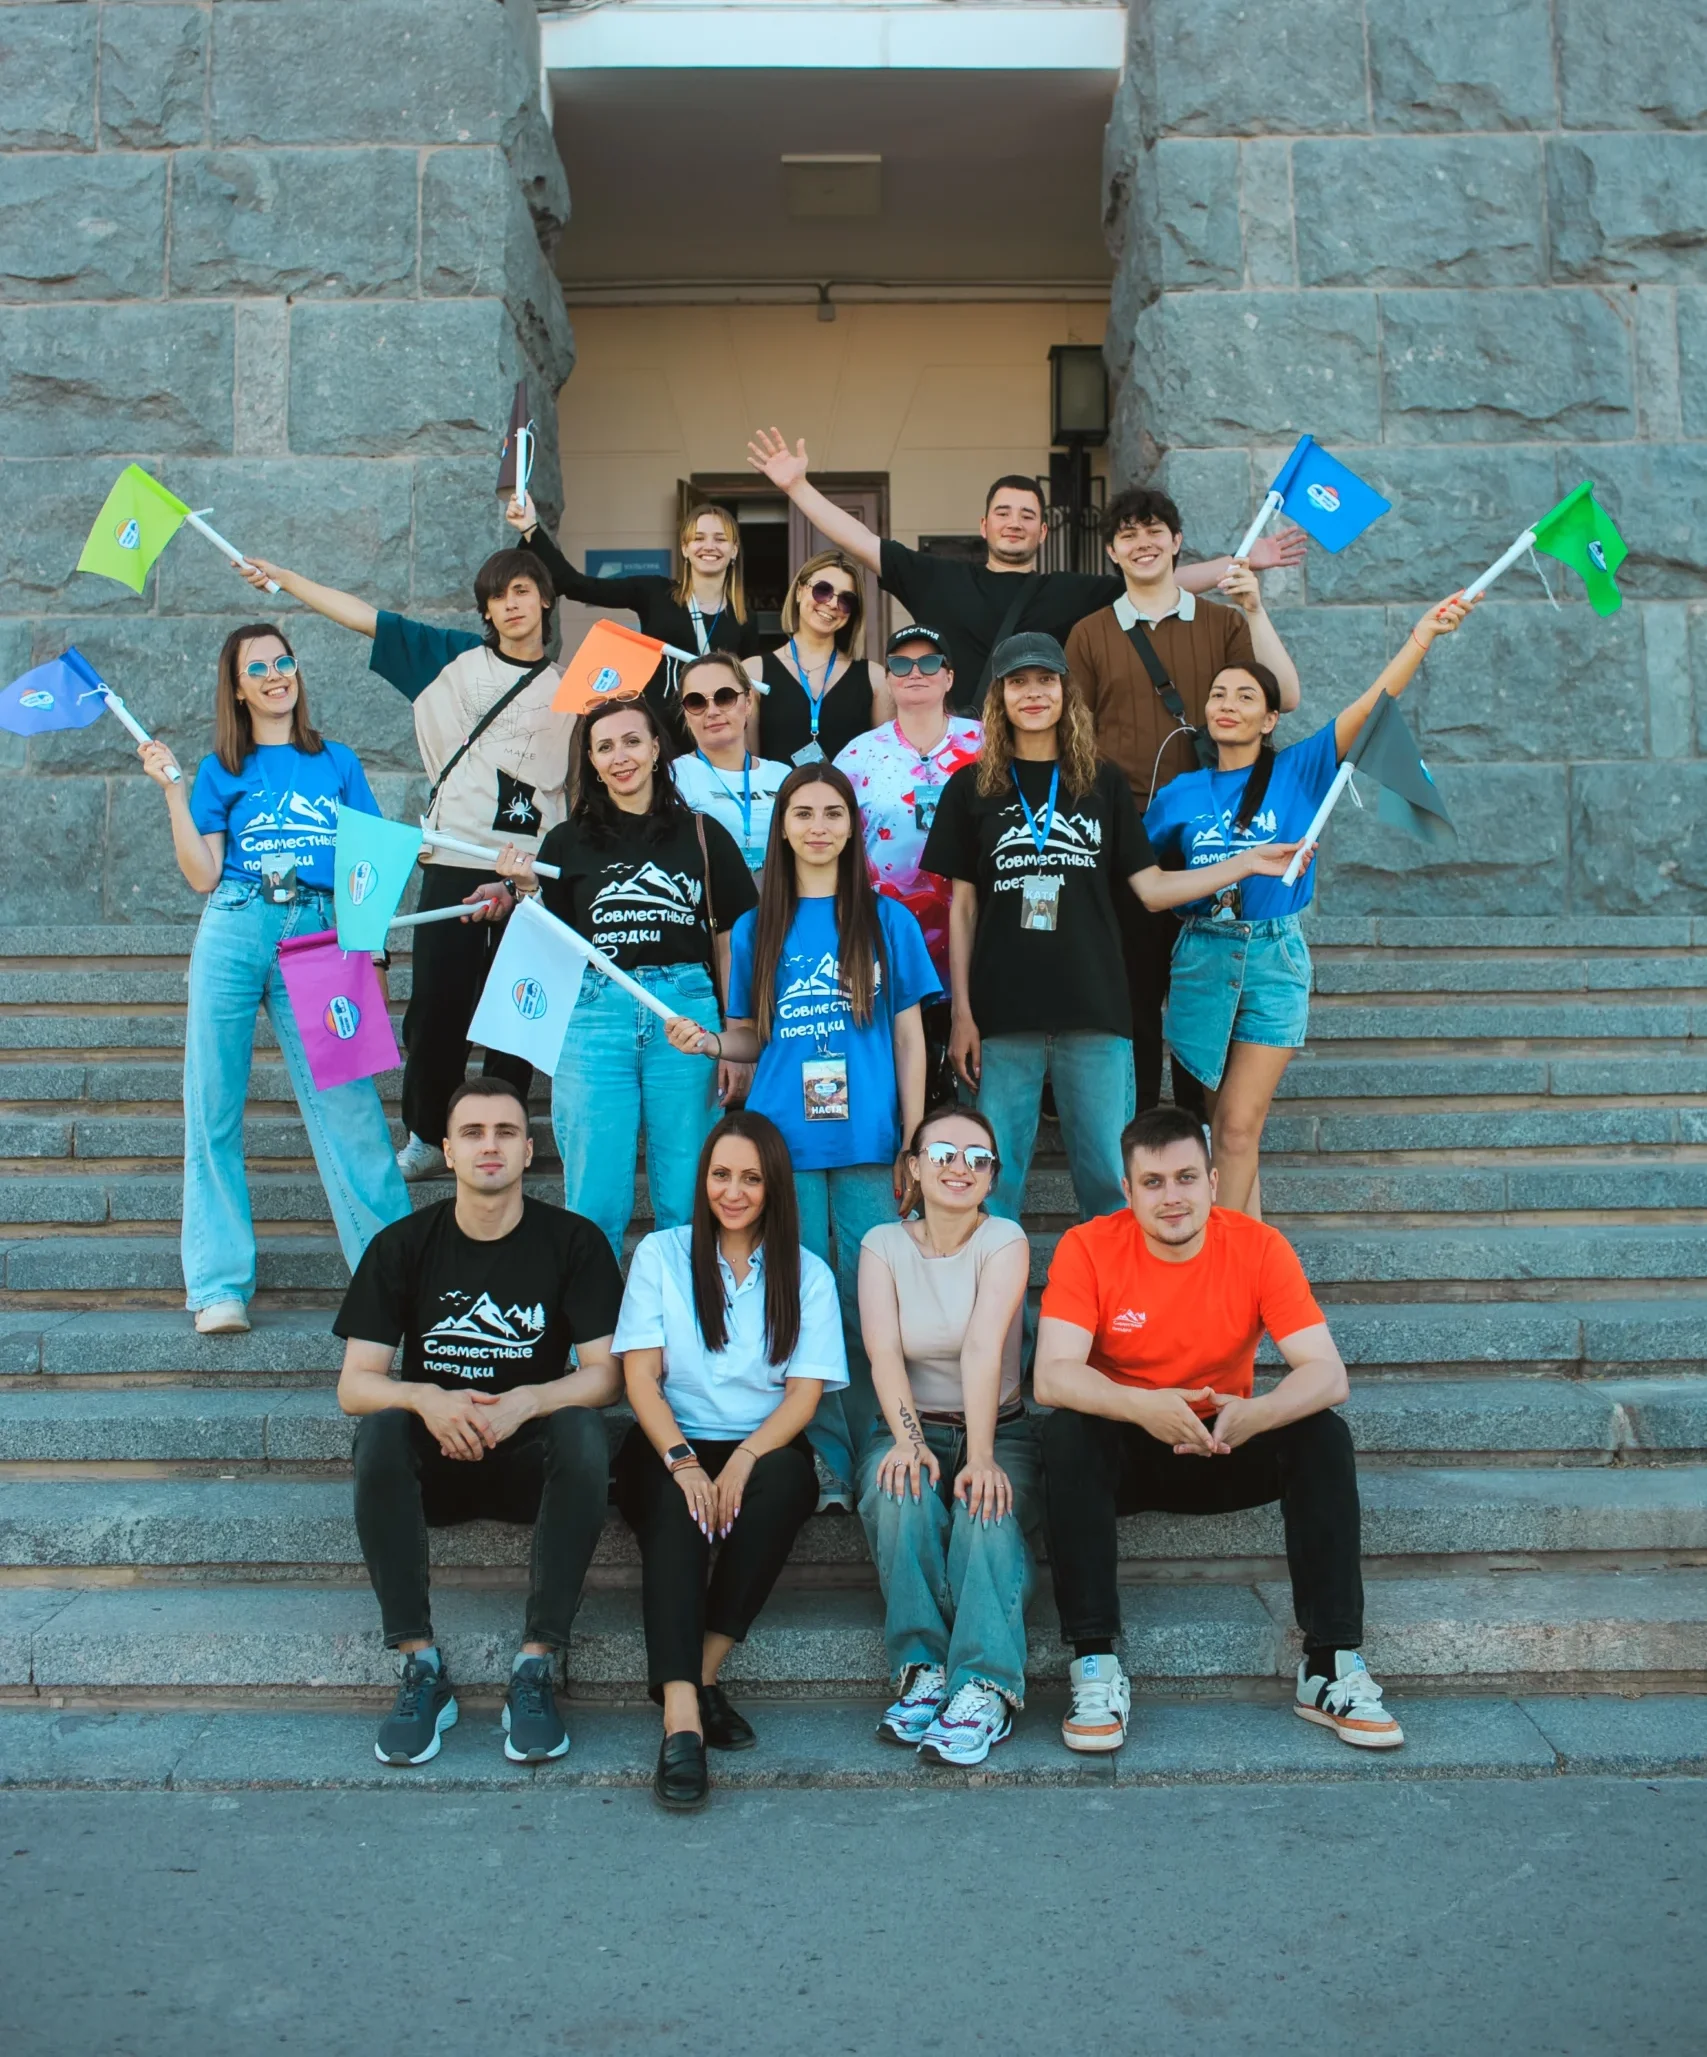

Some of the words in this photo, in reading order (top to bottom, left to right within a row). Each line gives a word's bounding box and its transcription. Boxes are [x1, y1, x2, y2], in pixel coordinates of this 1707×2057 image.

[241, 835, 337, 852] Совместные
[243, 854, 315, 871] поки
[995, 852, 1097, 871] Совместные
[1025, 889, 1057, 902] КАТЯ
[592, 907, 696, 926] Совместные
[592, 929, 661, 945] поездки
[779, 1000, 853, 1019] Совместн
[780, 1019, 846, 1040] поездки
[811, 1104, 843, 1115] НАСТЯ
[423, 1339, 533, 1359] Совместные
[423, 1360, 495, 1380] поездки
